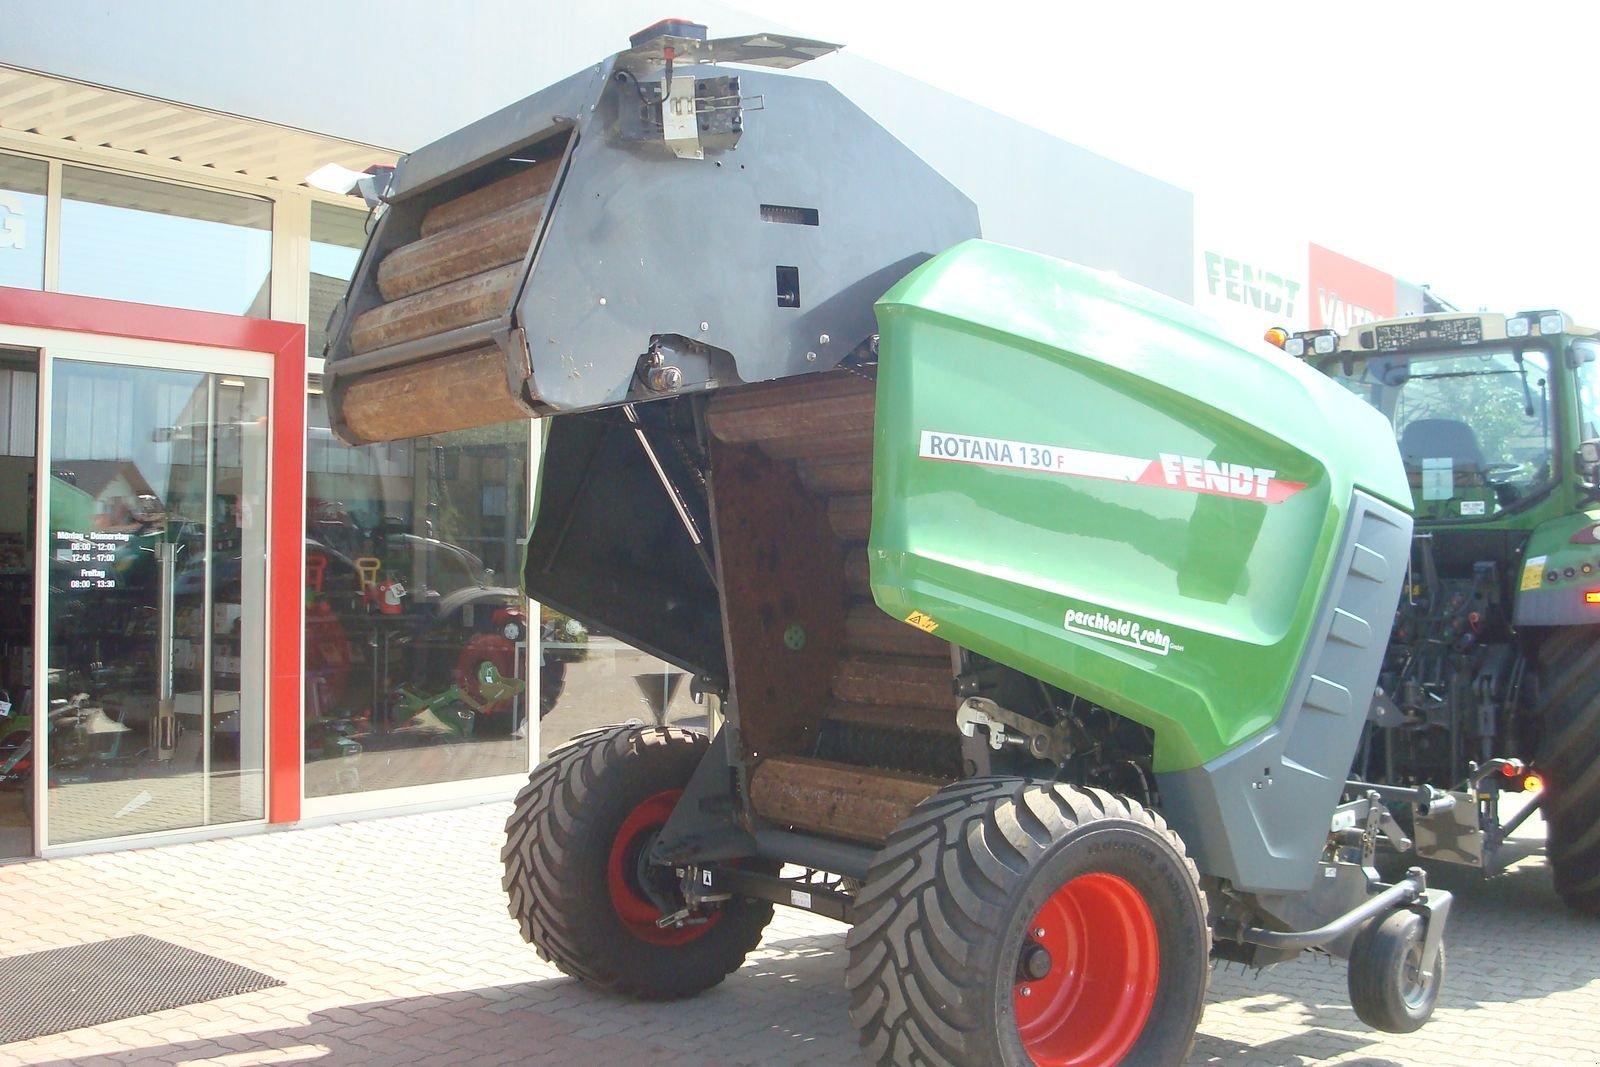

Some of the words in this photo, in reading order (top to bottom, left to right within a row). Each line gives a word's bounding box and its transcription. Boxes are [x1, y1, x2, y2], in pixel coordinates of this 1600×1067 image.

[1204, 250, 1300, 318] FENDT
[1318, 287, 1384, 330] VALT
[929, 434, 1014, 464] ROTANA
[1018, 446, 1053, 468] 130
[1057, 455, 1065, 470] F
[1158, 452, 1277, 499] FENDT
[90, 532, 129, 541] Donnerstag
[97, 543, 116, 551] 12:00
[72, 554, 91, 562] 12:45
[97, 554, 115, 562] 17:00
[81, 569, 106, 578] Freitag
[70, 580, 91, 588] 08:00
[97, 580, 115, 588] 13:30
